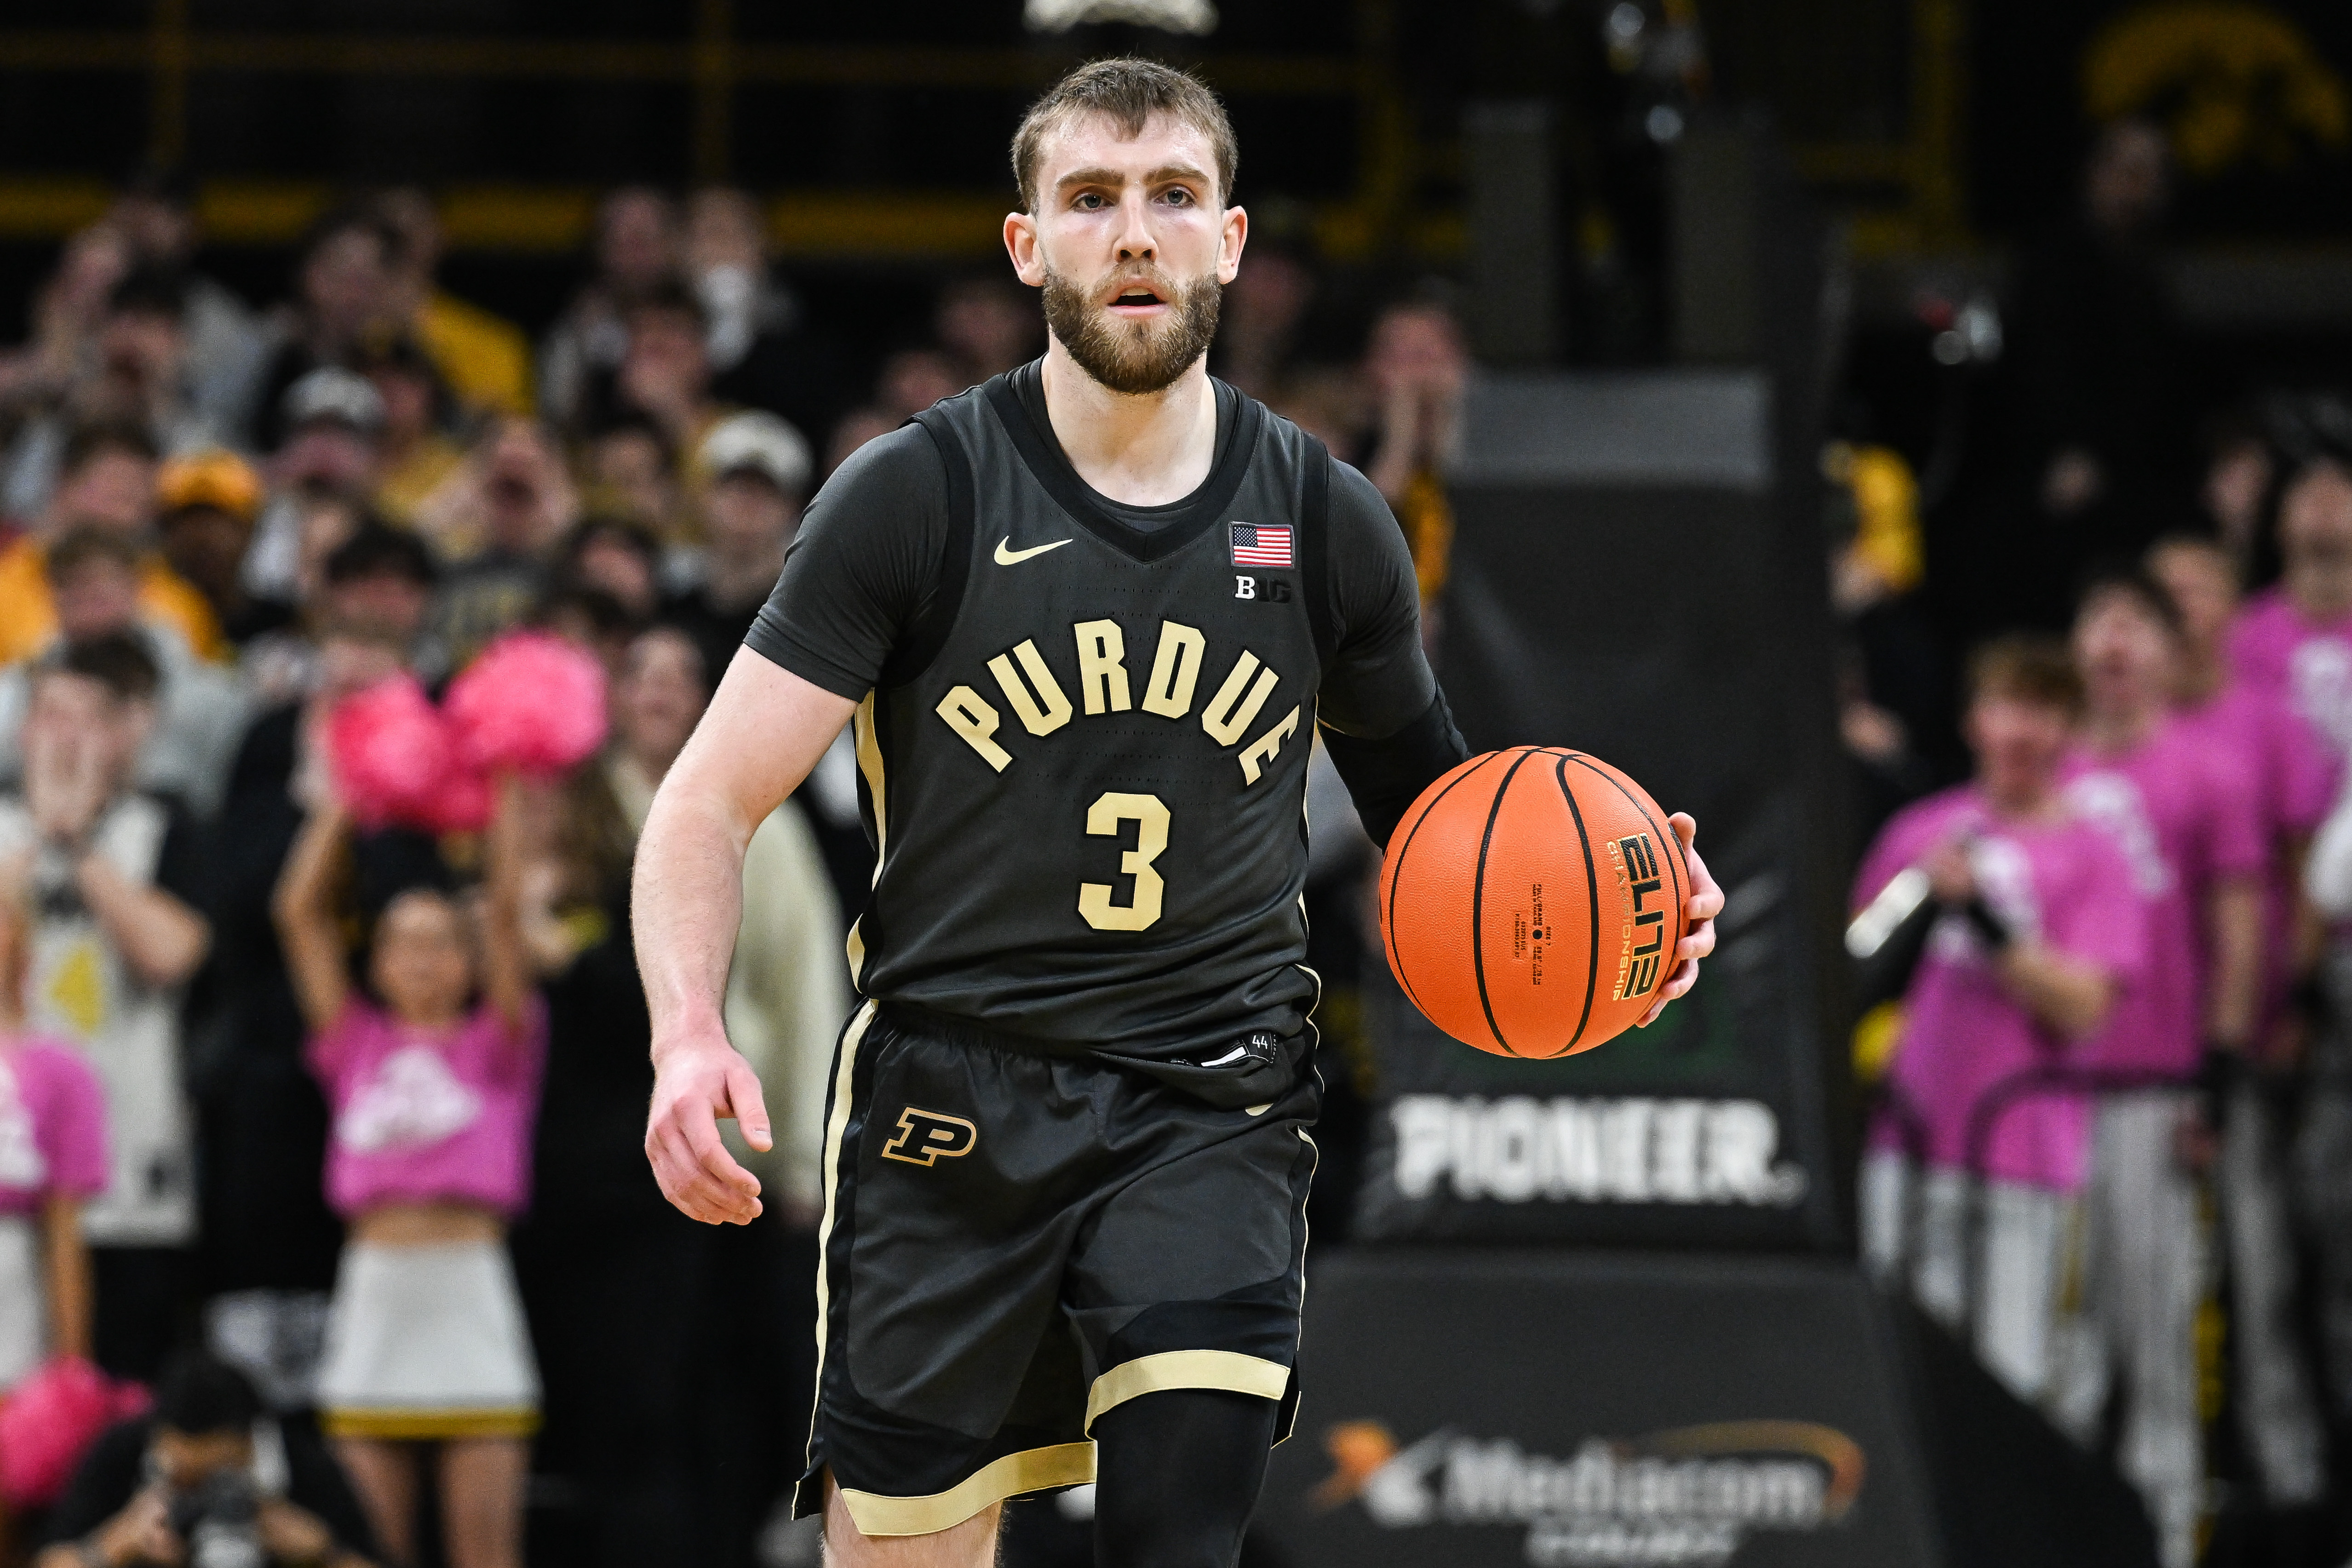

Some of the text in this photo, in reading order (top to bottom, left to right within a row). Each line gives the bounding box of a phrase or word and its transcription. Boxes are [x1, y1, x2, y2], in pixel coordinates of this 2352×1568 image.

[935, 618, 1301, 786] PURDUE
[1078, 792, 1171, 931] 3
[1618, 833, 1664, 1000] ELITE
[1252, 1035, 1268, 1049] 44
[882, 1107, 976, 1167] P
[1391, 1093, 1780, 1206] PIONEER
